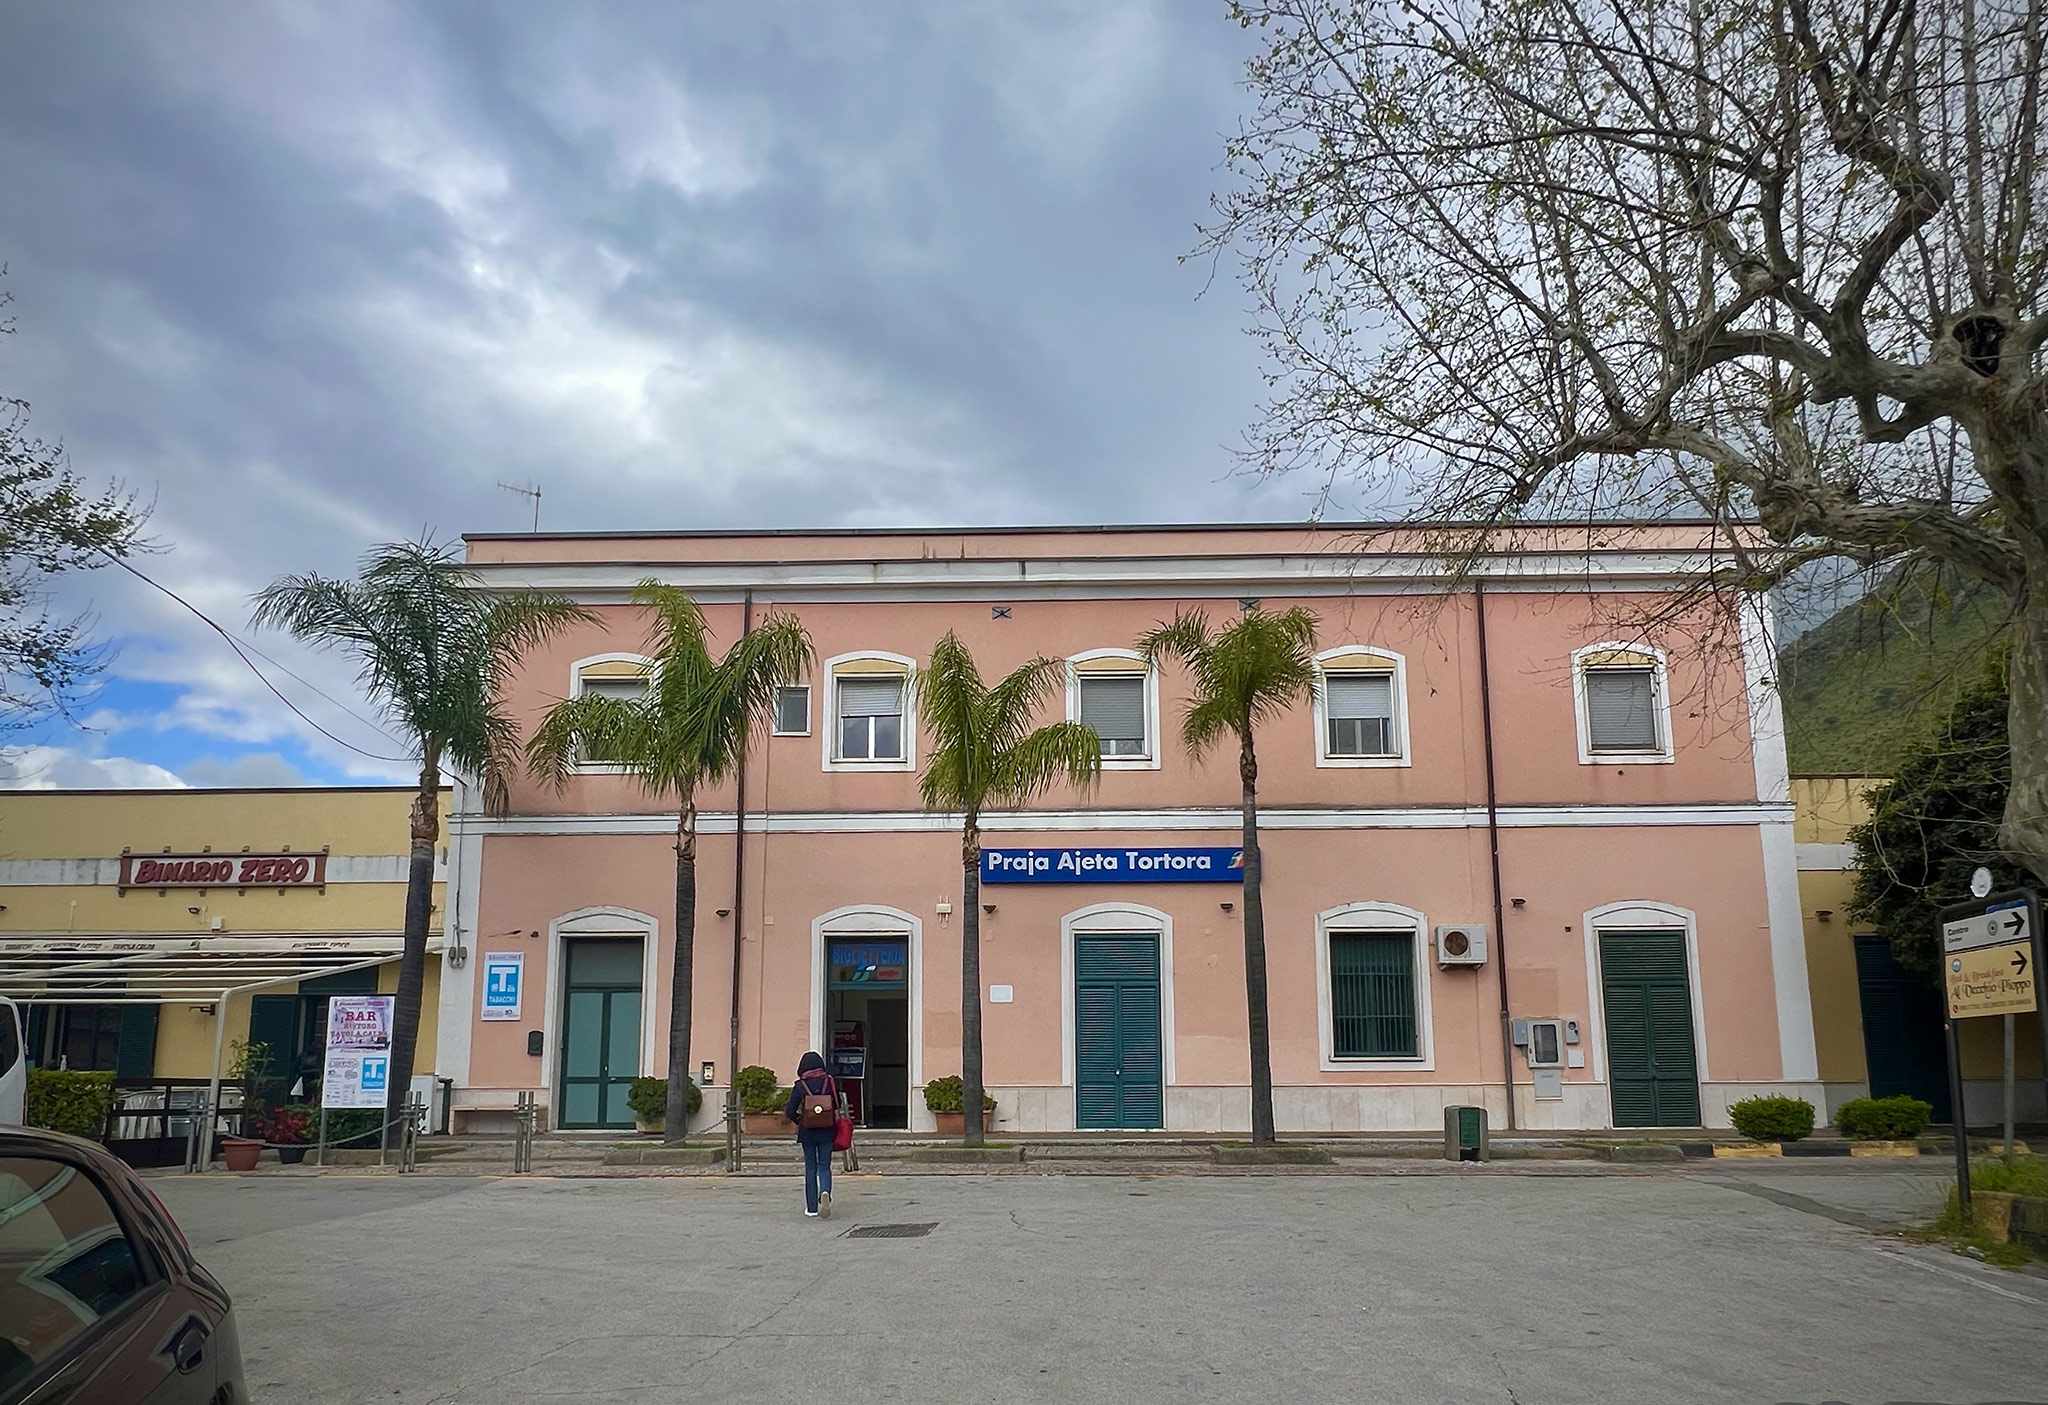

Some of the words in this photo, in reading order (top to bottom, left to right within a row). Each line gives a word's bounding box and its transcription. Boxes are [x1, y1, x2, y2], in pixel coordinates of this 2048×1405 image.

[134, 860, 233, 883] BINARIO
[238, 858, 310, 883] ZERO
[988, 851, 1049, 876] Praja
[1057, 851, 1118, 876] Ajeta
[1125, 851, 1211, 870] Tortora
[491, 966, 517, 992] T
[344, 1011, 377, 1021] BAR
[364, 1059, 385, 1079] T
